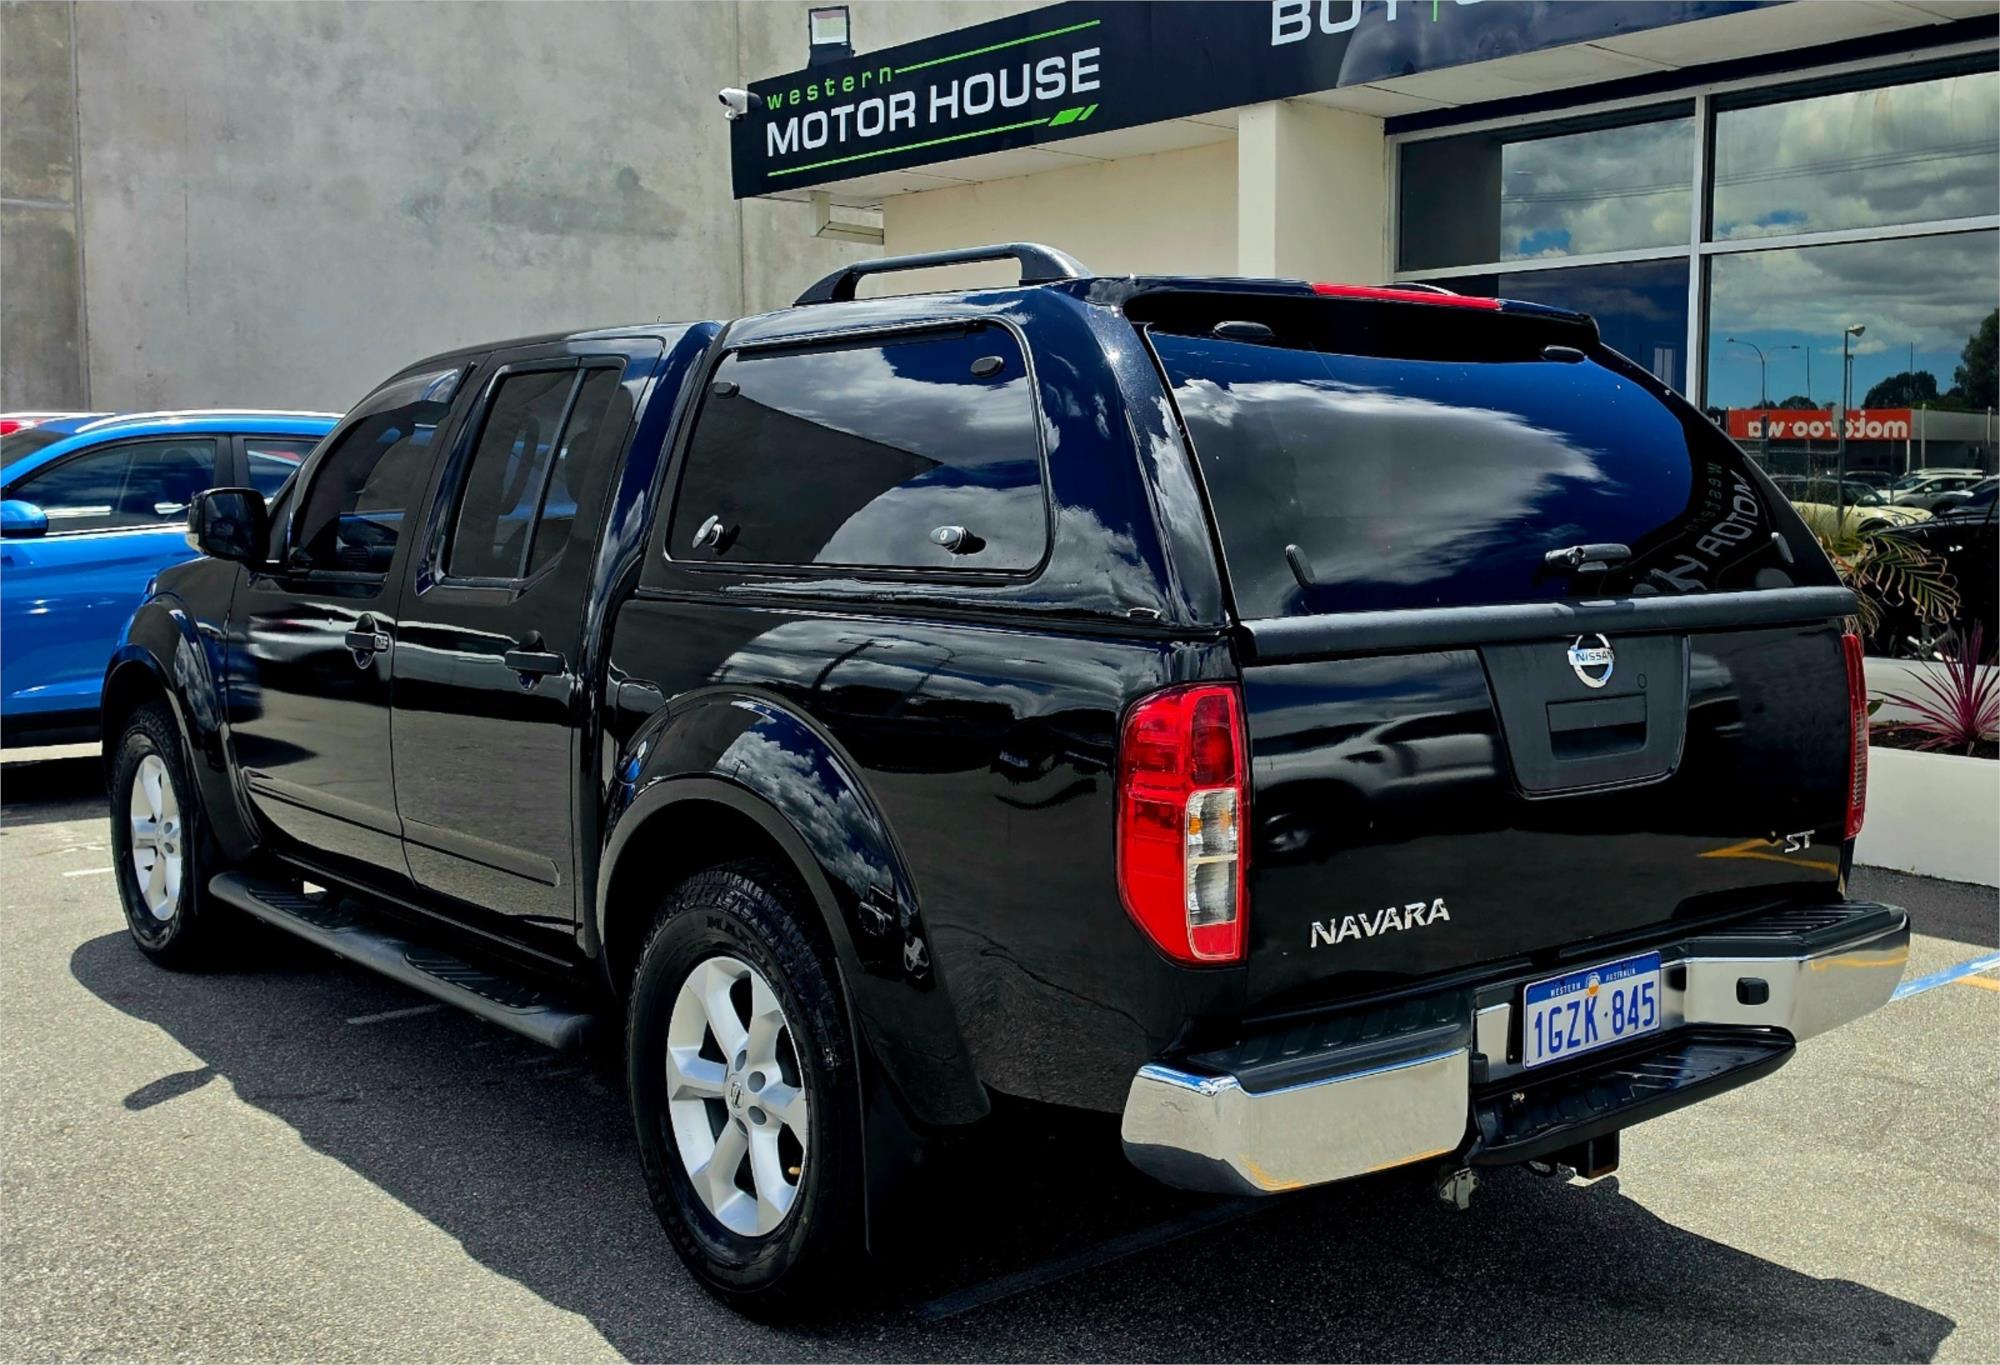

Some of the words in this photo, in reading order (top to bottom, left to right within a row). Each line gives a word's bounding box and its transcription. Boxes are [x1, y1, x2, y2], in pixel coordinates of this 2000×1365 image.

[766, 90, 916, 157] MOTOR
[929, 47, 1101, 123] HOUSE
[767, 66, 892, 110] western
[1784, 829, 1816, 854] ST
[1310, 897, 1451, 949] NAVARA
[1550, 981, 1582, 997] WESTERN
